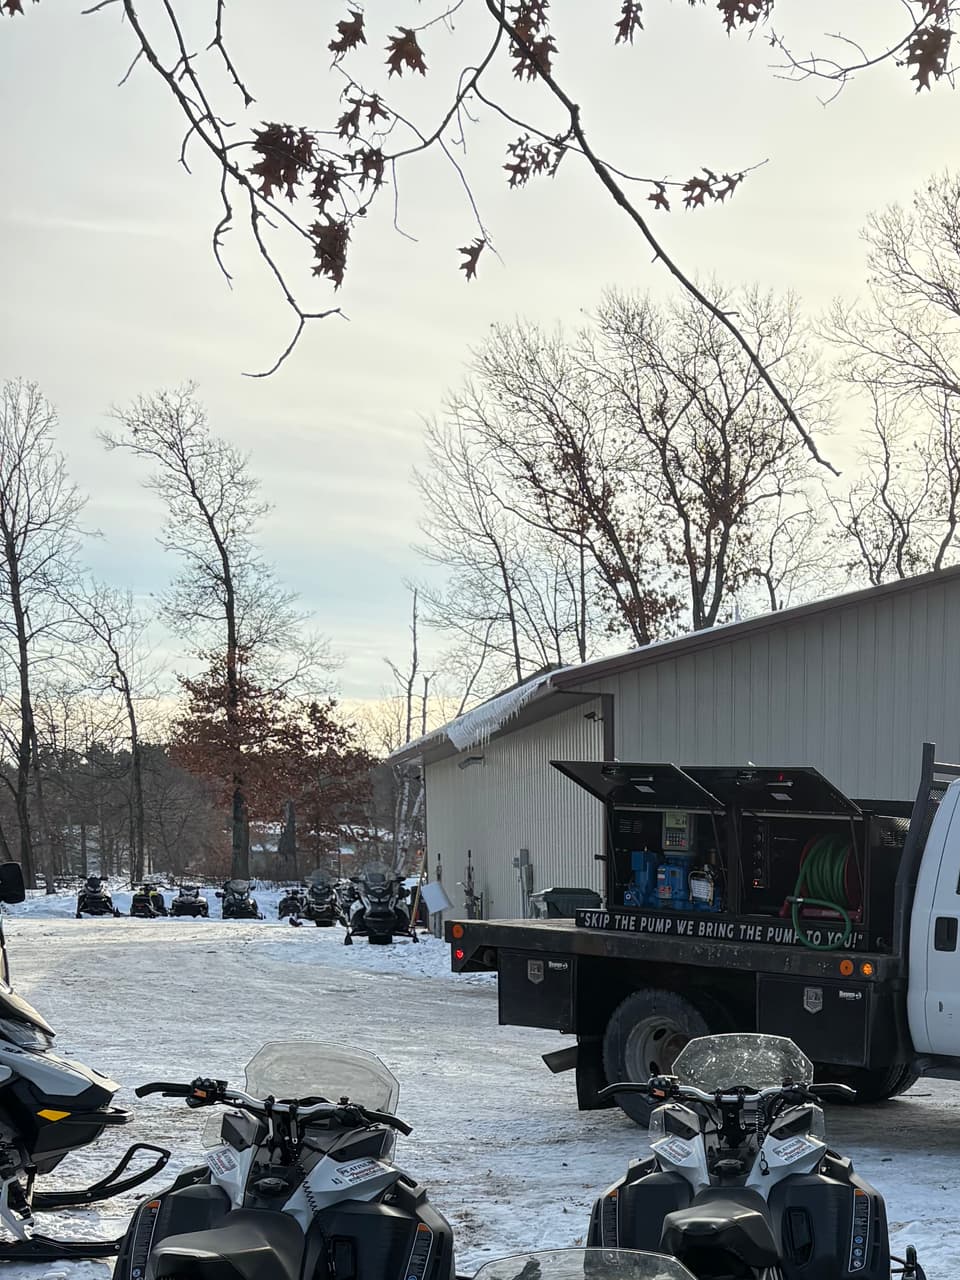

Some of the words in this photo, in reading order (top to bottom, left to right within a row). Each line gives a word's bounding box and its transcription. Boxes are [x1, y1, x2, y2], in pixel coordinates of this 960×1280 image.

[580, 912, 610, 928] "SKIP
[615, 914, 637, 931] THE
[640, 917, 672, 934] PUMP
[677, 920, 693, 936] WE
[698, 922, 734, 939] BRING
[740, 925, 763, 941] THE
[806, 930, 822, 946] TO
